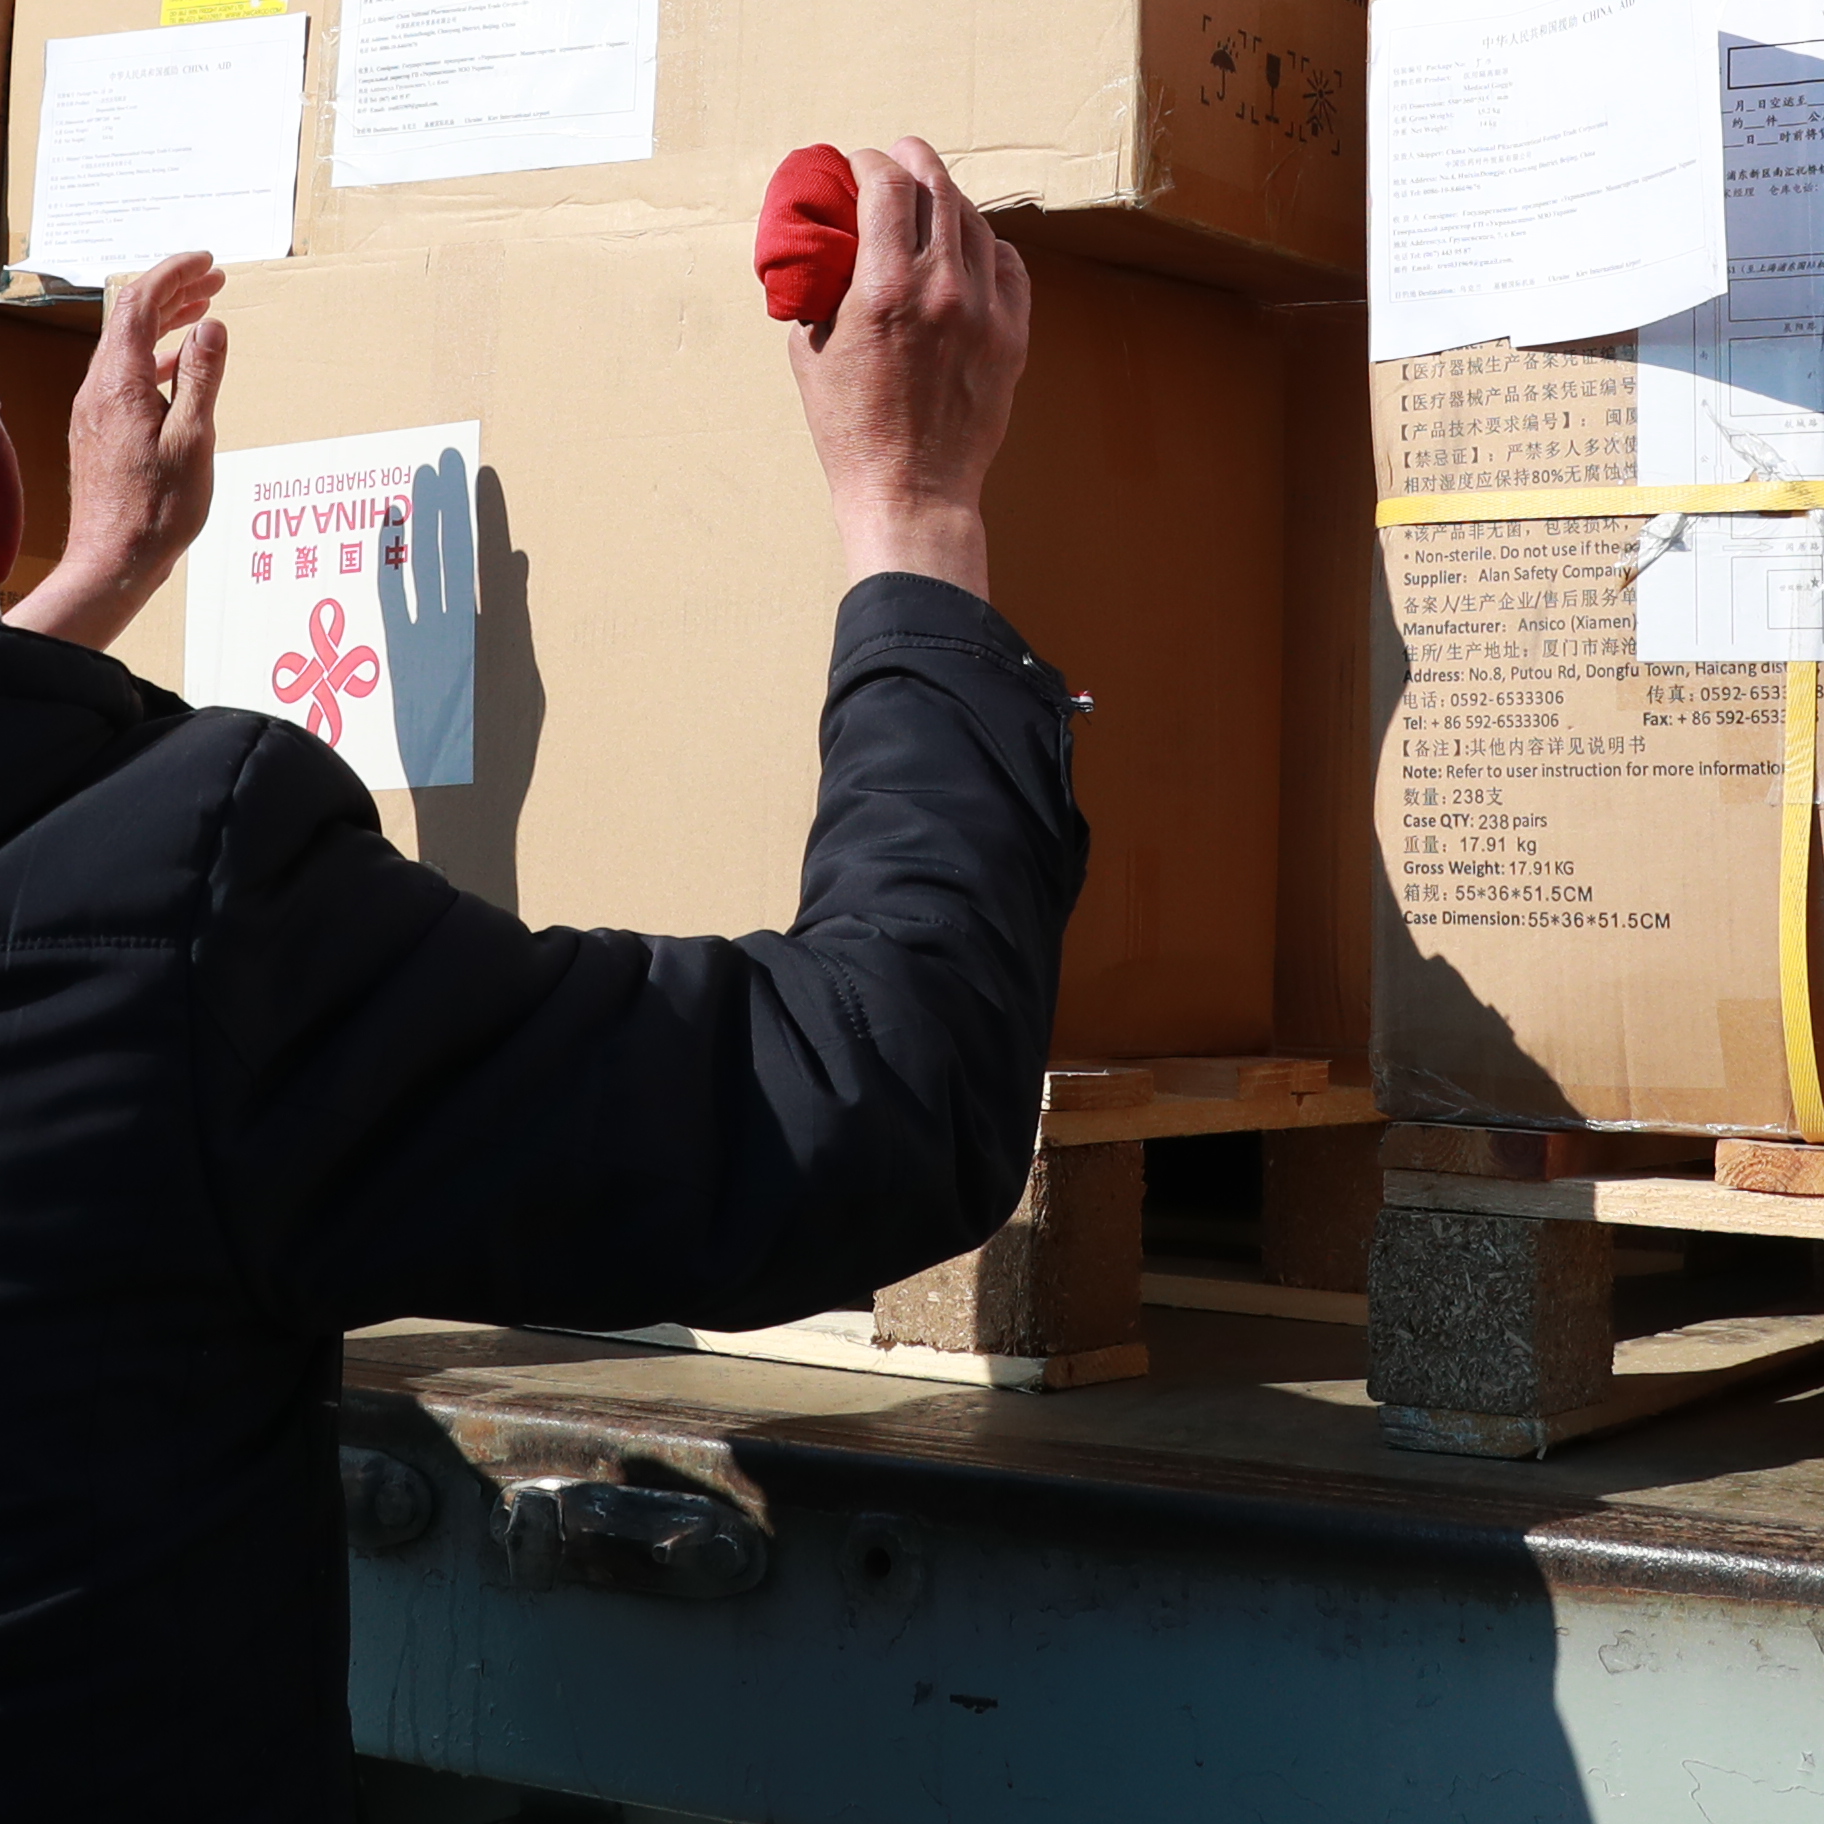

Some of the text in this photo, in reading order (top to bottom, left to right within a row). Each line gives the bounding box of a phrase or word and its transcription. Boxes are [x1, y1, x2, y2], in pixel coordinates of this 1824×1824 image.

[1582, 4, 1613, 25] CHINA
[182, 60, 232, 75] CHINA AID
[254, 466, 411, 502] FOR SHARED FUTURE
[251, 494, 413, 541] CHINA AID
[251, 536, 408, 585] 中国援助
[1478, 560, 1632, 583] Alan Safety Company
[1517, 611, 1637, 633] Ansico (Xiamen)
[1402, 661, 1757, 684] Address: Putou Dongfu Haicang
[1466, 712, 1559, 731] 592-6533306
[1402, 760, 1694, 780] Note: Refer user instruction more
[1402, 812, 1548, 831] Case QTY: 238 pairs
[1403, 859, 1505, 878] Gross Weight:
[1402, 910, 1437, 926] Case
[1442, 910, 1525, 927] Dimension:
